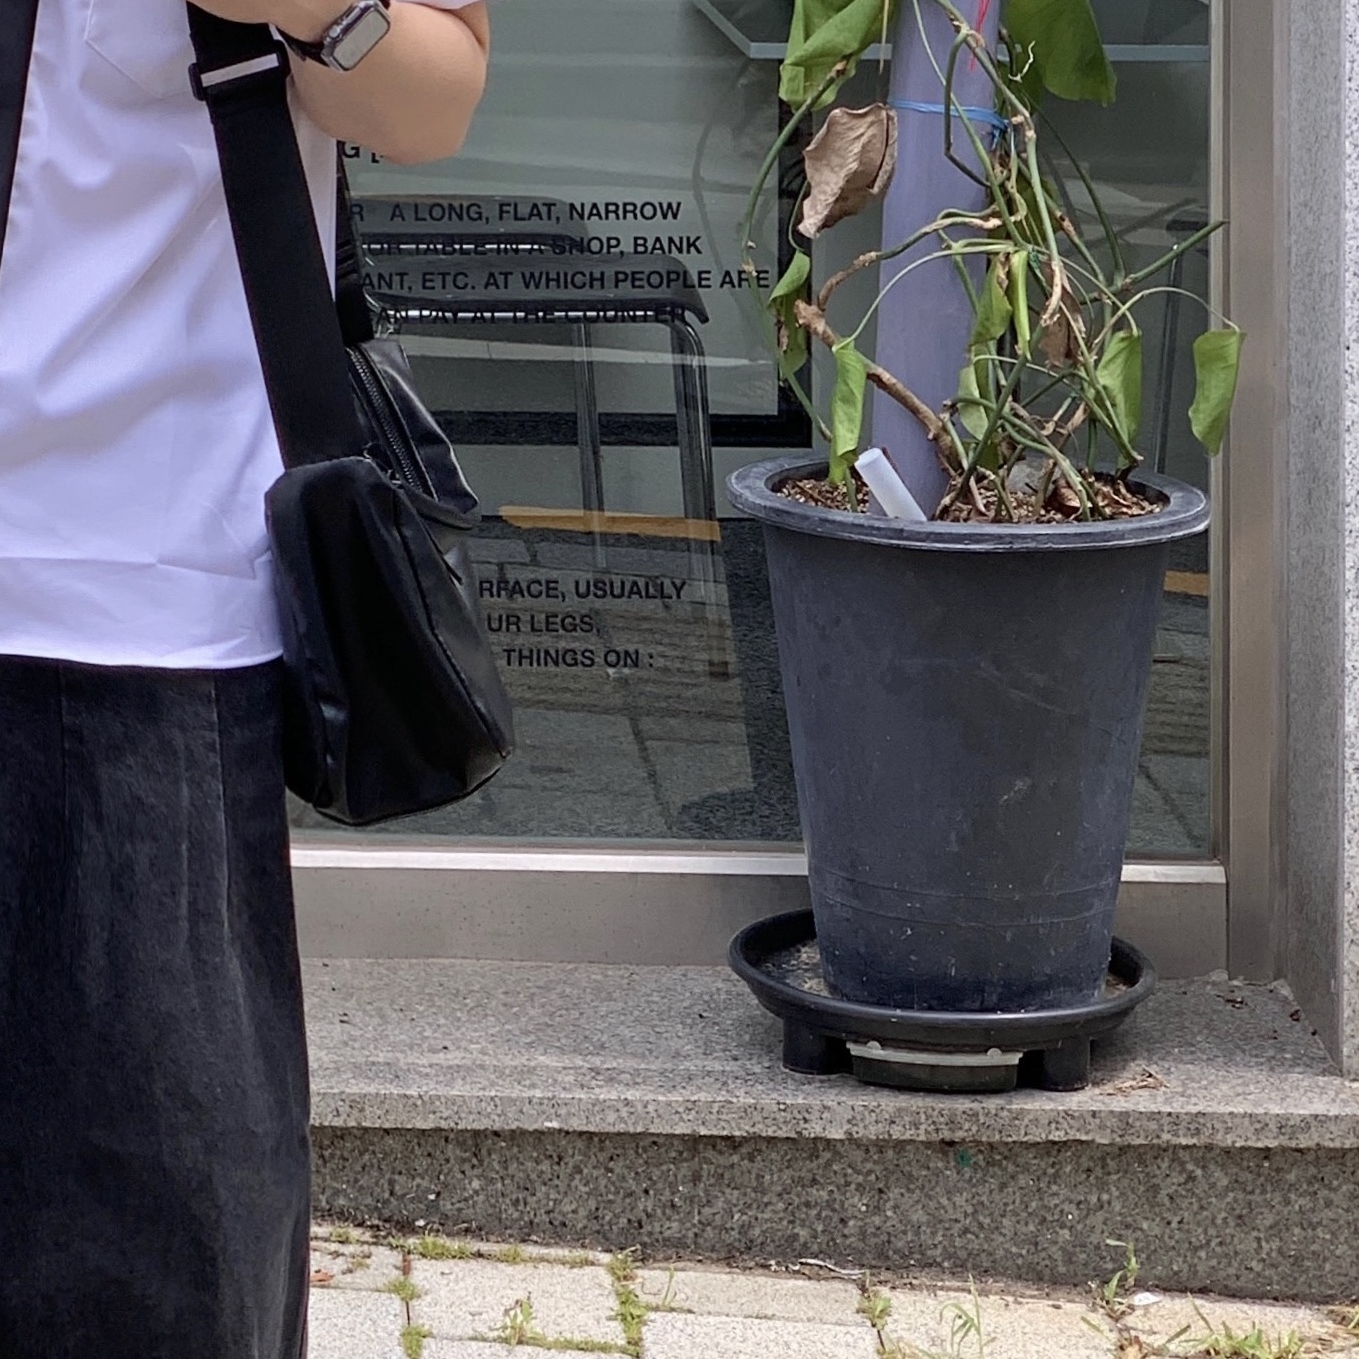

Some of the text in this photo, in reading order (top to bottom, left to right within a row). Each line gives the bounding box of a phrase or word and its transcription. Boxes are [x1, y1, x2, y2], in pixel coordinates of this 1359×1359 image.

[390, 203, 406, 221] A
[414, 203, 490, 224] LONG,
[498, 202, 561, 224] FLAT,
[569, 201, 682, 221] NARROW
[551, 236, 624, 257] SHOP,
[633, 236, 703, 255] BANK
[421, 272, 475, 290] ETC.
[484, 271, 513, 290] AT
[521, 270, 606, 290] WHICH
[614, 270, 712, 289] PEOPLE
[574, 580, 687, 600] USUALLY
[503, 649, 595, 667] THINGS
[604, 649, 640, 668] ON
